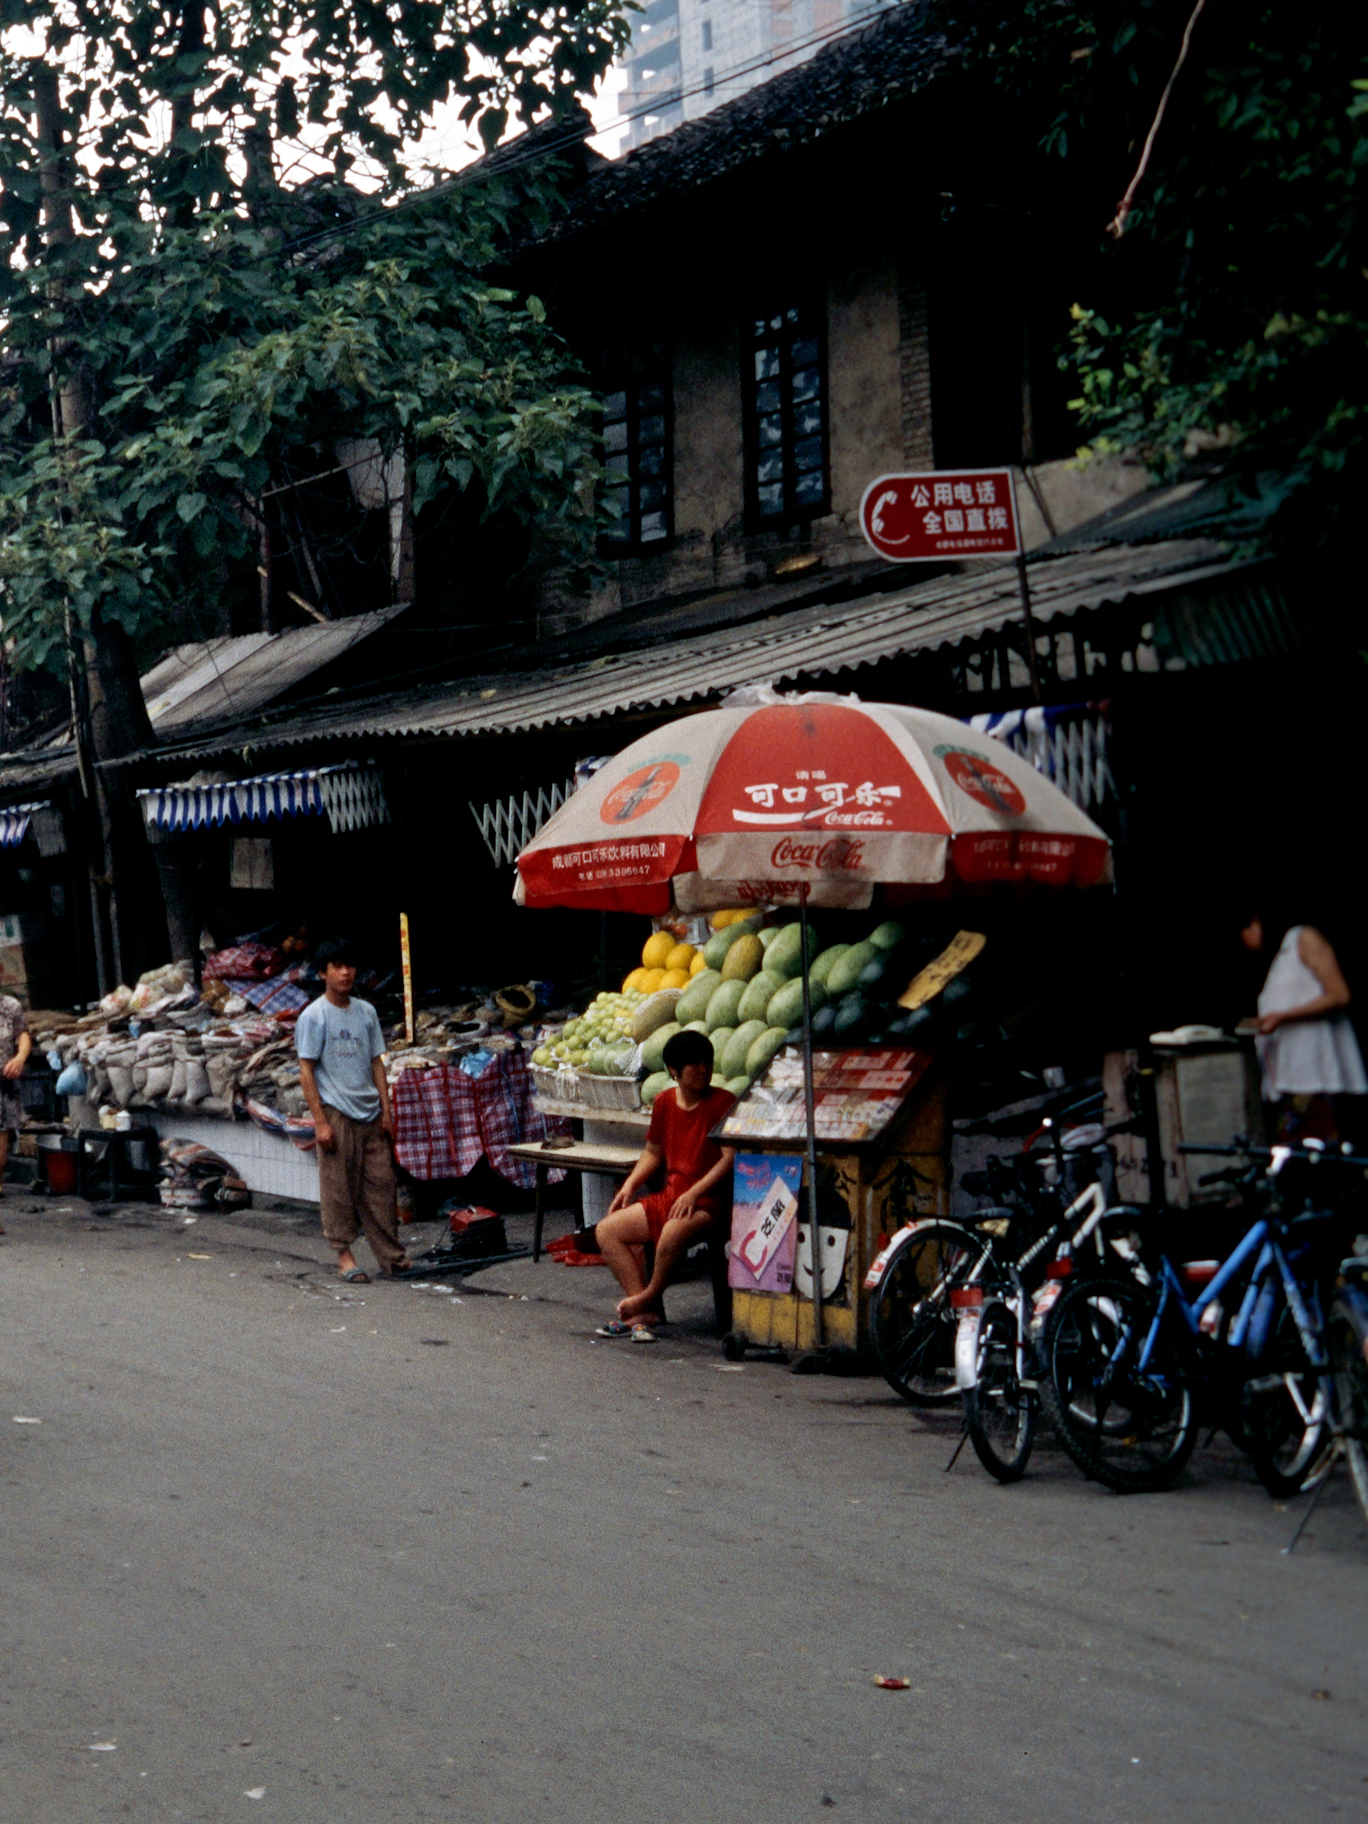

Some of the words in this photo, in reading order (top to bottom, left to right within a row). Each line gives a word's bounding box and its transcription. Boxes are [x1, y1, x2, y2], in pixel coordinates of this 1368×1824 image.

[911, 480, 996, 508] 公用电话
[922, 506, 1009, 535] 全国直拨
[744, 781, 901, 807] 可口可乐
[824, 810, 885, 825] Coca-Cola
[552, 842, 666, 870] 成都可口可乐饮料有限公司
[770, 837, 866, 869] Coca-Cola
